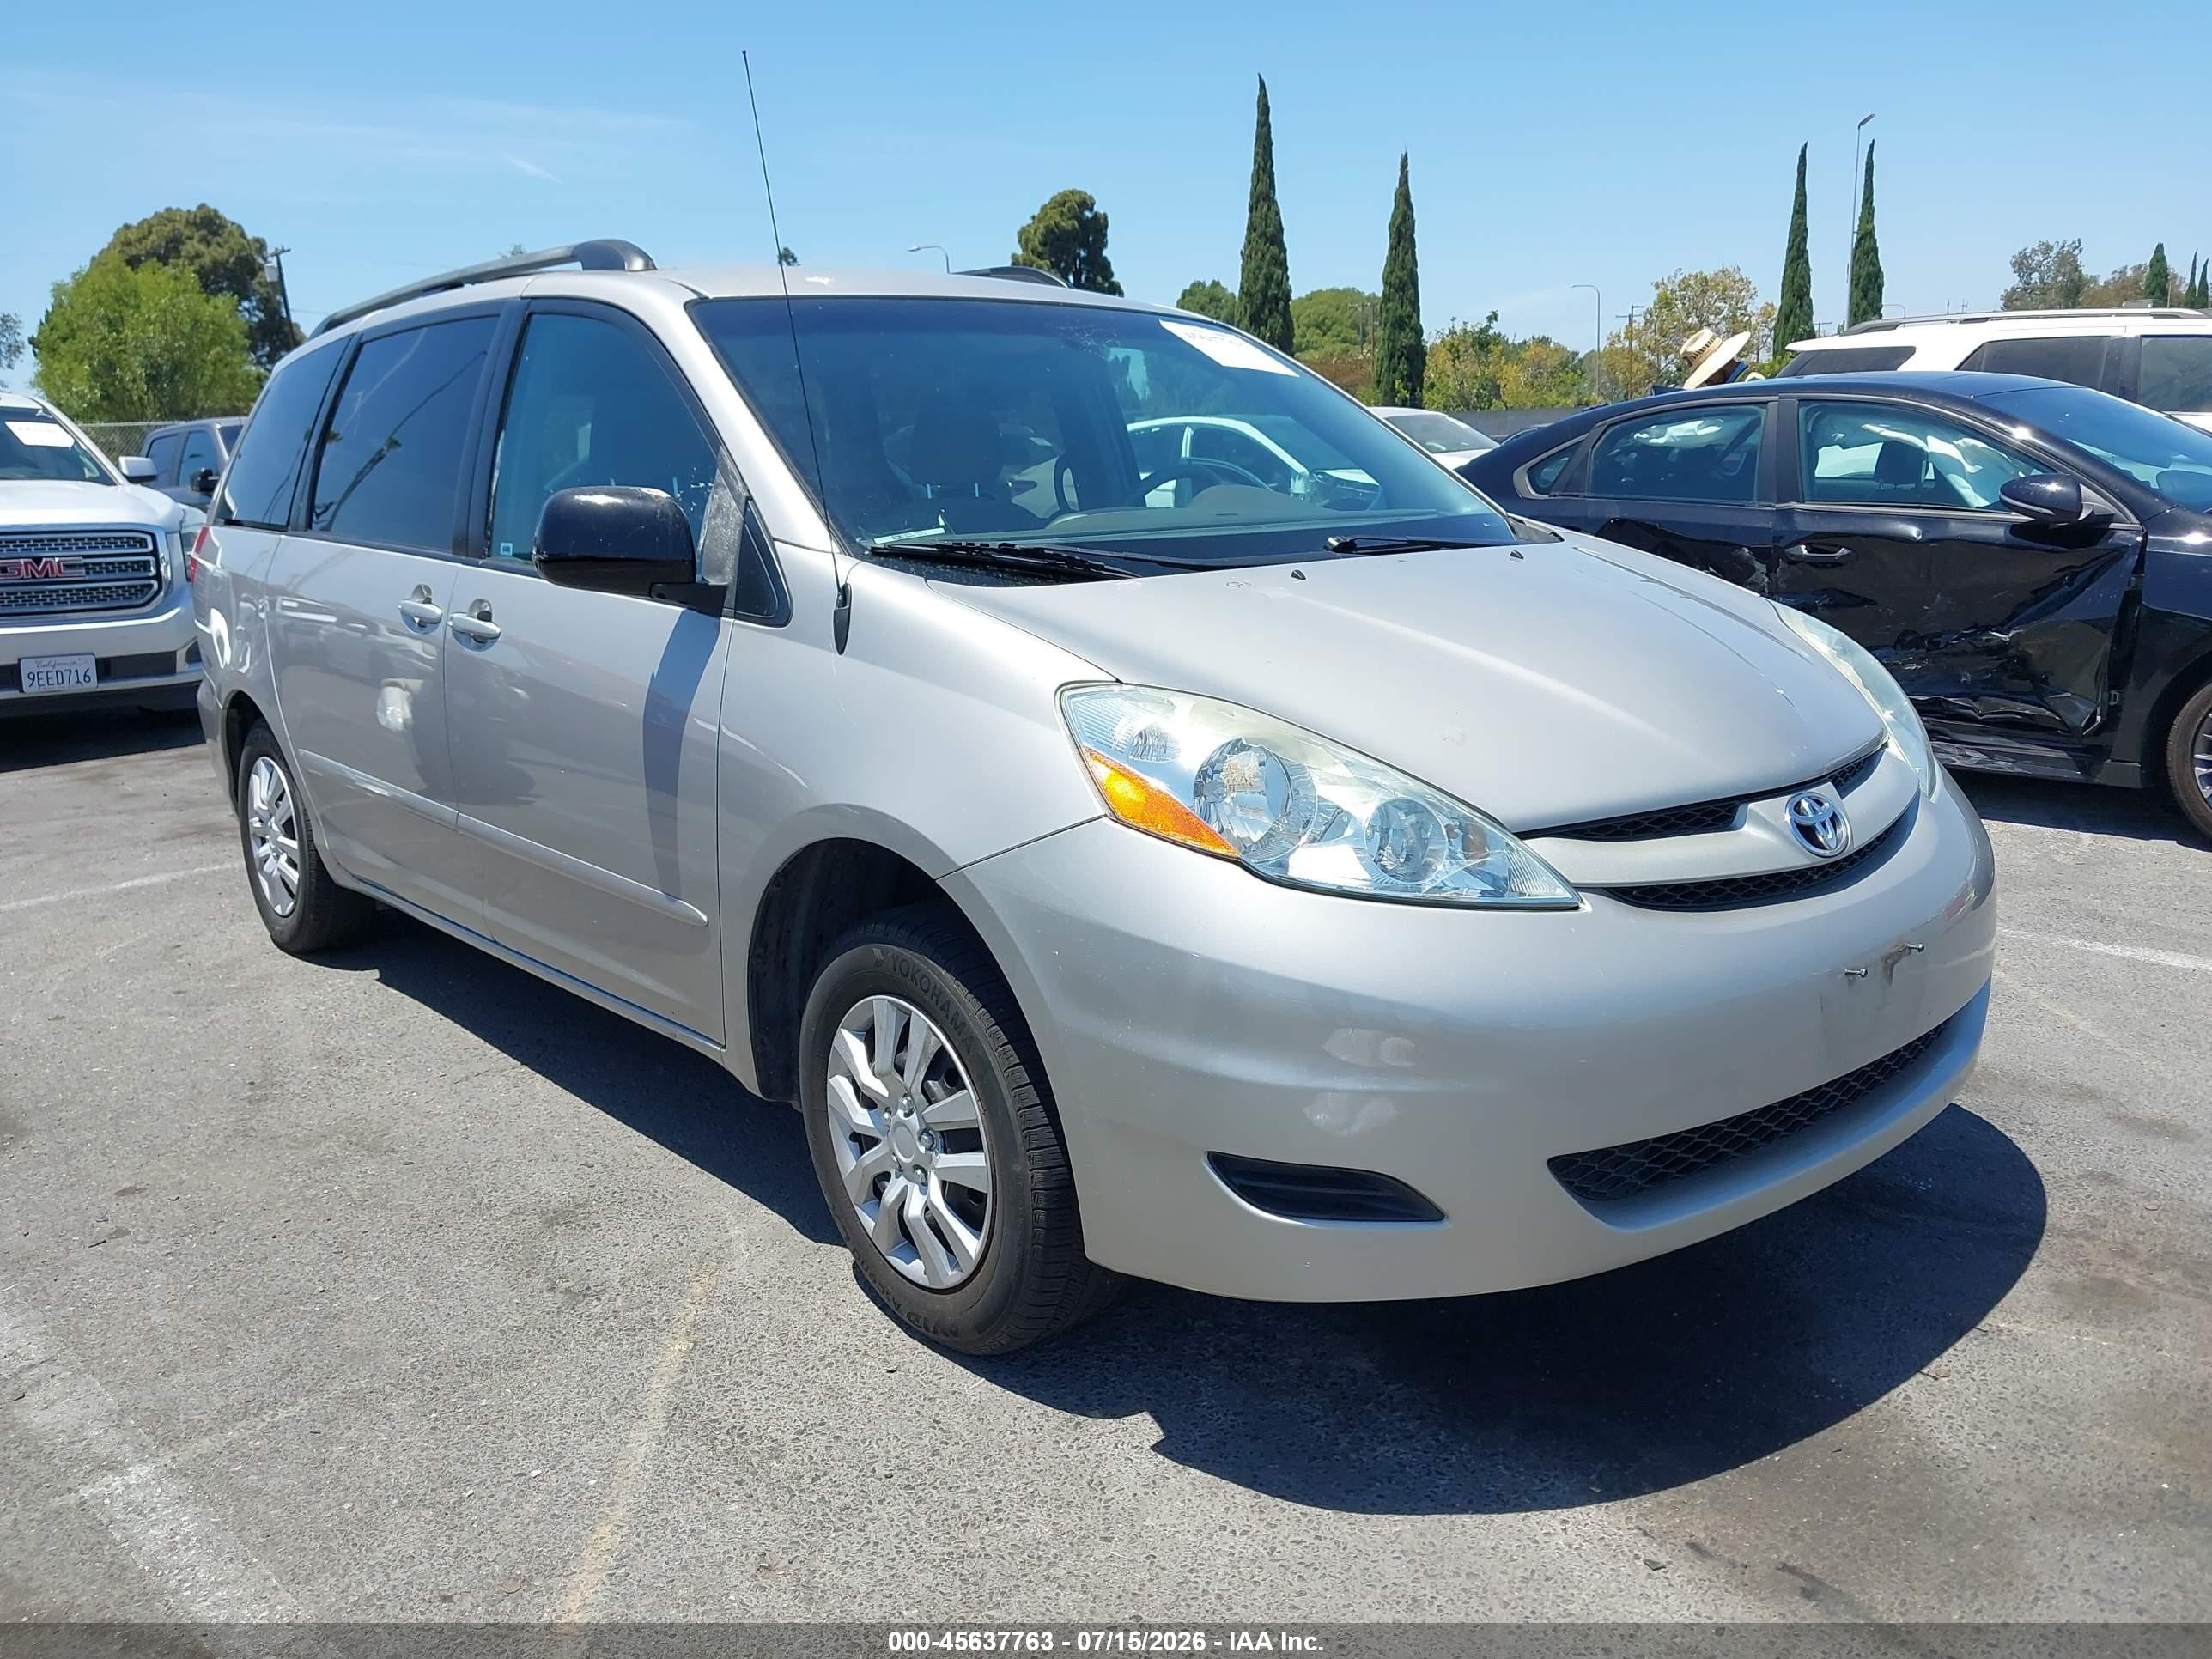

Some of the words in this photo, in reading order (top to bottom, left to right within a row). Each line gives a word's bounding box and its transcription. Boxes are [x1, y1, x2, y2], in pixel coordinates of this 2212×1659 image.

[0, 557, 85, 579] GMC
[27, 667, 92, 688] 9EED716
[890, 954, 975, 1054] YOKOHAMA
